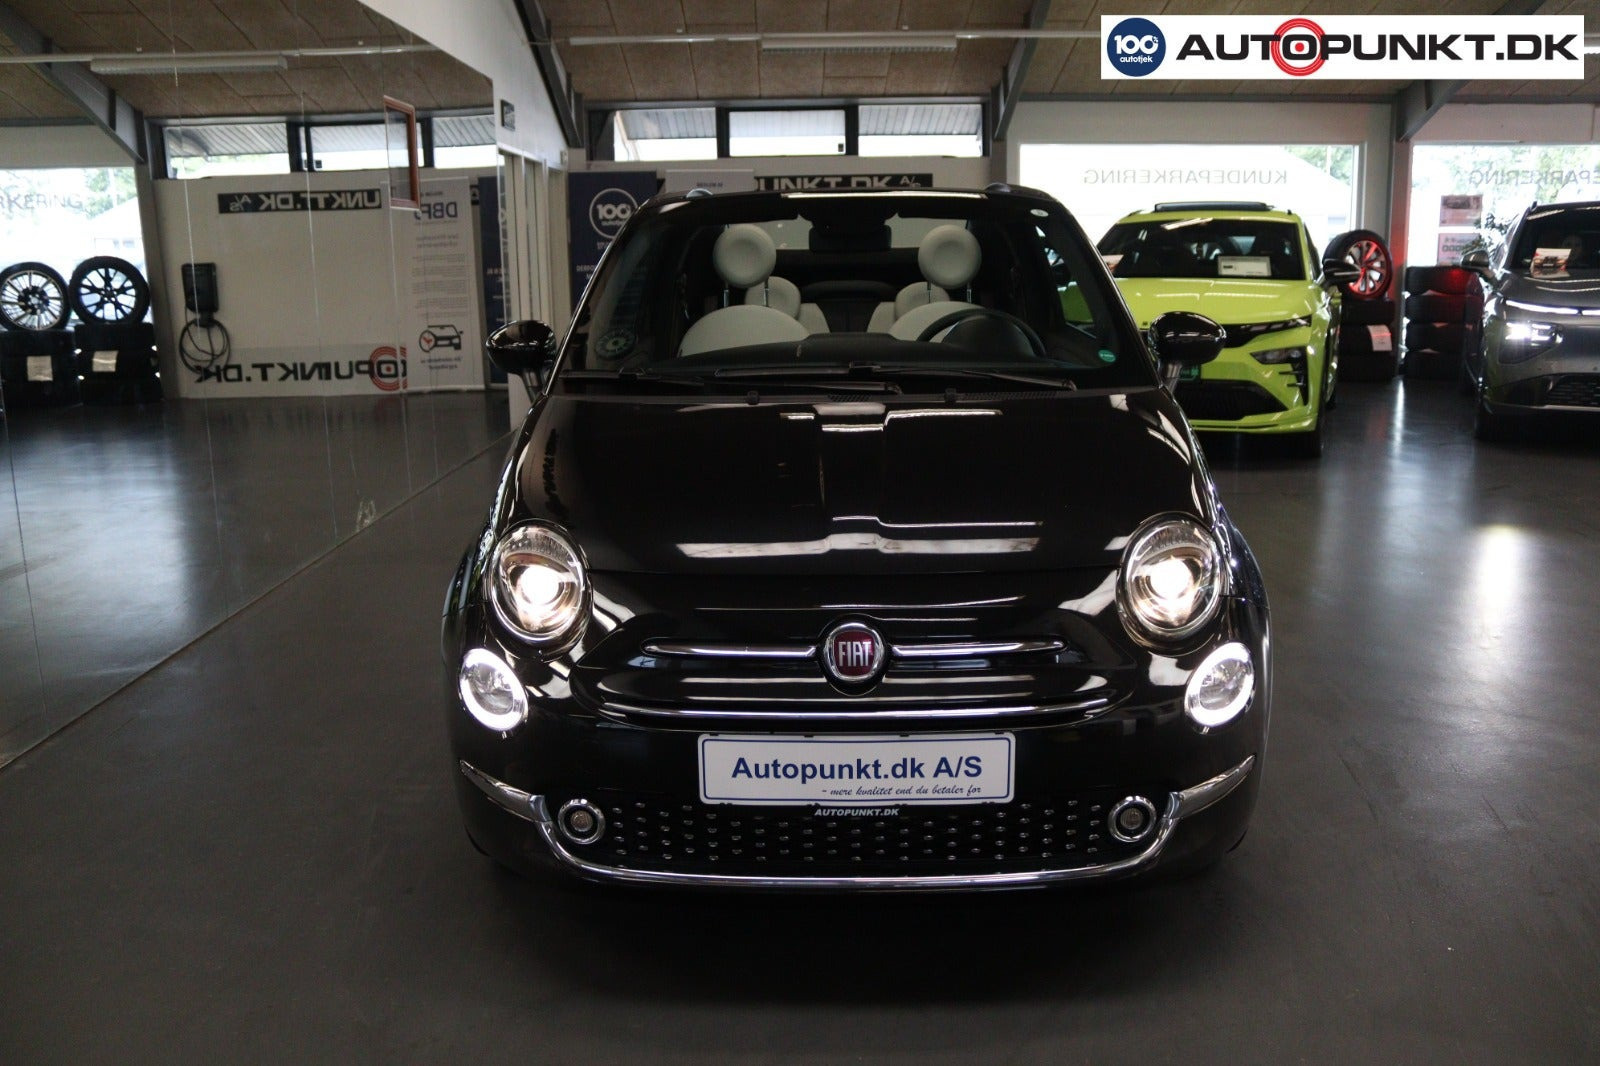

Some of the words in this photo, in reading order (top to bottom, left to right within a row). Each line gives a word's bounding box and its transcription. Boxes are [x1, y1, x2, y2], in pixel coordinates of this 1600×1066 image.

[755, 176, 893, 191] UNKTDK
[838, 641, 872, 667] FIAT
[731, 757, 925, 785] Autopunkt.dk
[932, 755, 983, 779] A/S
[830, 788, 852, 796] mere
[856, 786, 893, 796] kvalitet
[895, 785, 913, 795] end
[916, 785, 929, 795] du
[932, 784, 964, 795] betaler
[967, 784, 982, 797] for
[814, 808, 900, 817] AUTOPUNKT.DK
